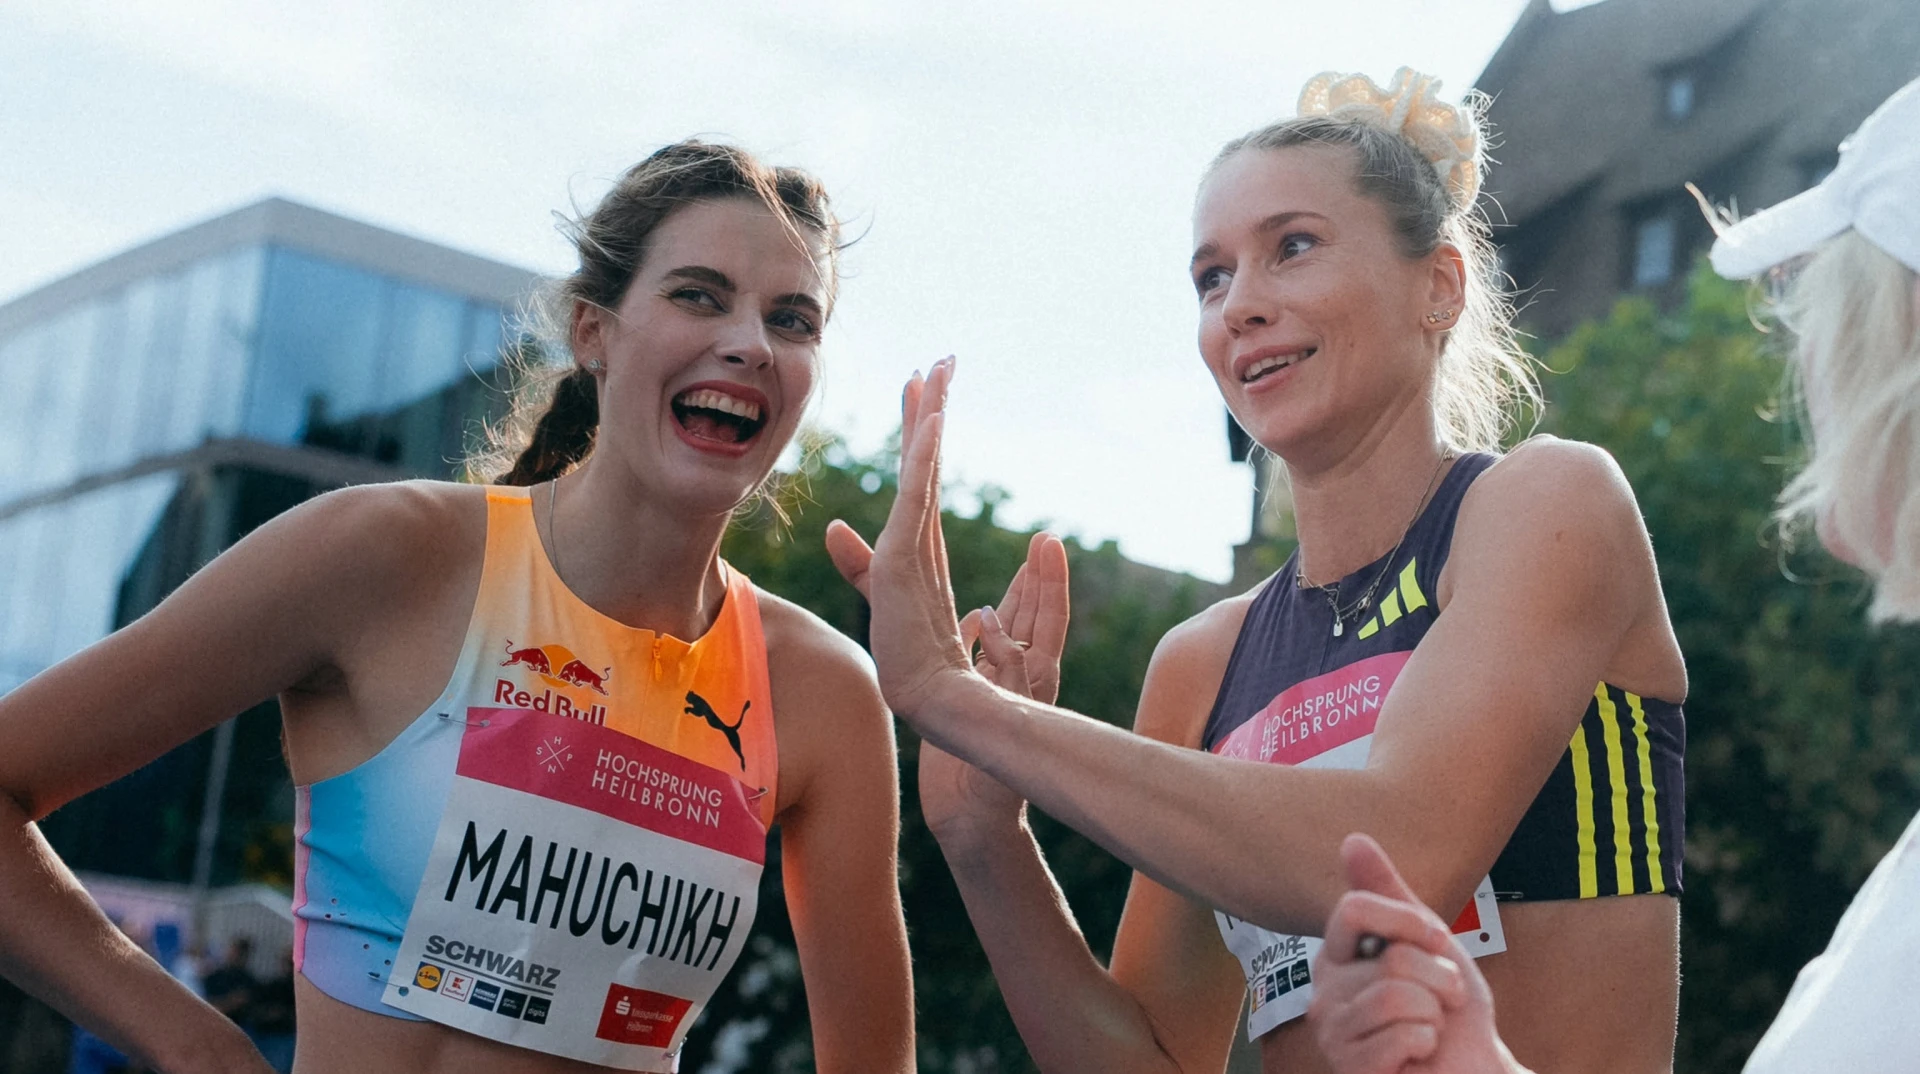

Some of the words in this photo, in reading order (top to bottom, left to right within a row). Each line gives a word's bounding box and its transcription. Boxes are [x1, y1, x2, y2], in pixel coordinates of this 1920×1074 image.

[494, 679, 551, 713] Red
[555, 694, 606, 726] Bull
[1259, 695, 1380, 760] HEILBRONN
[1262, 675, 1381, 742] HOCHSPRUNG
[591, 770, 720, 828] HEILBRONN
[596, 749, 722, 807] HOCHSPRUNG
[445, 820, 741, 971] MAHUCHIKH
[425, 935, 561, 989] SCHWARZ
